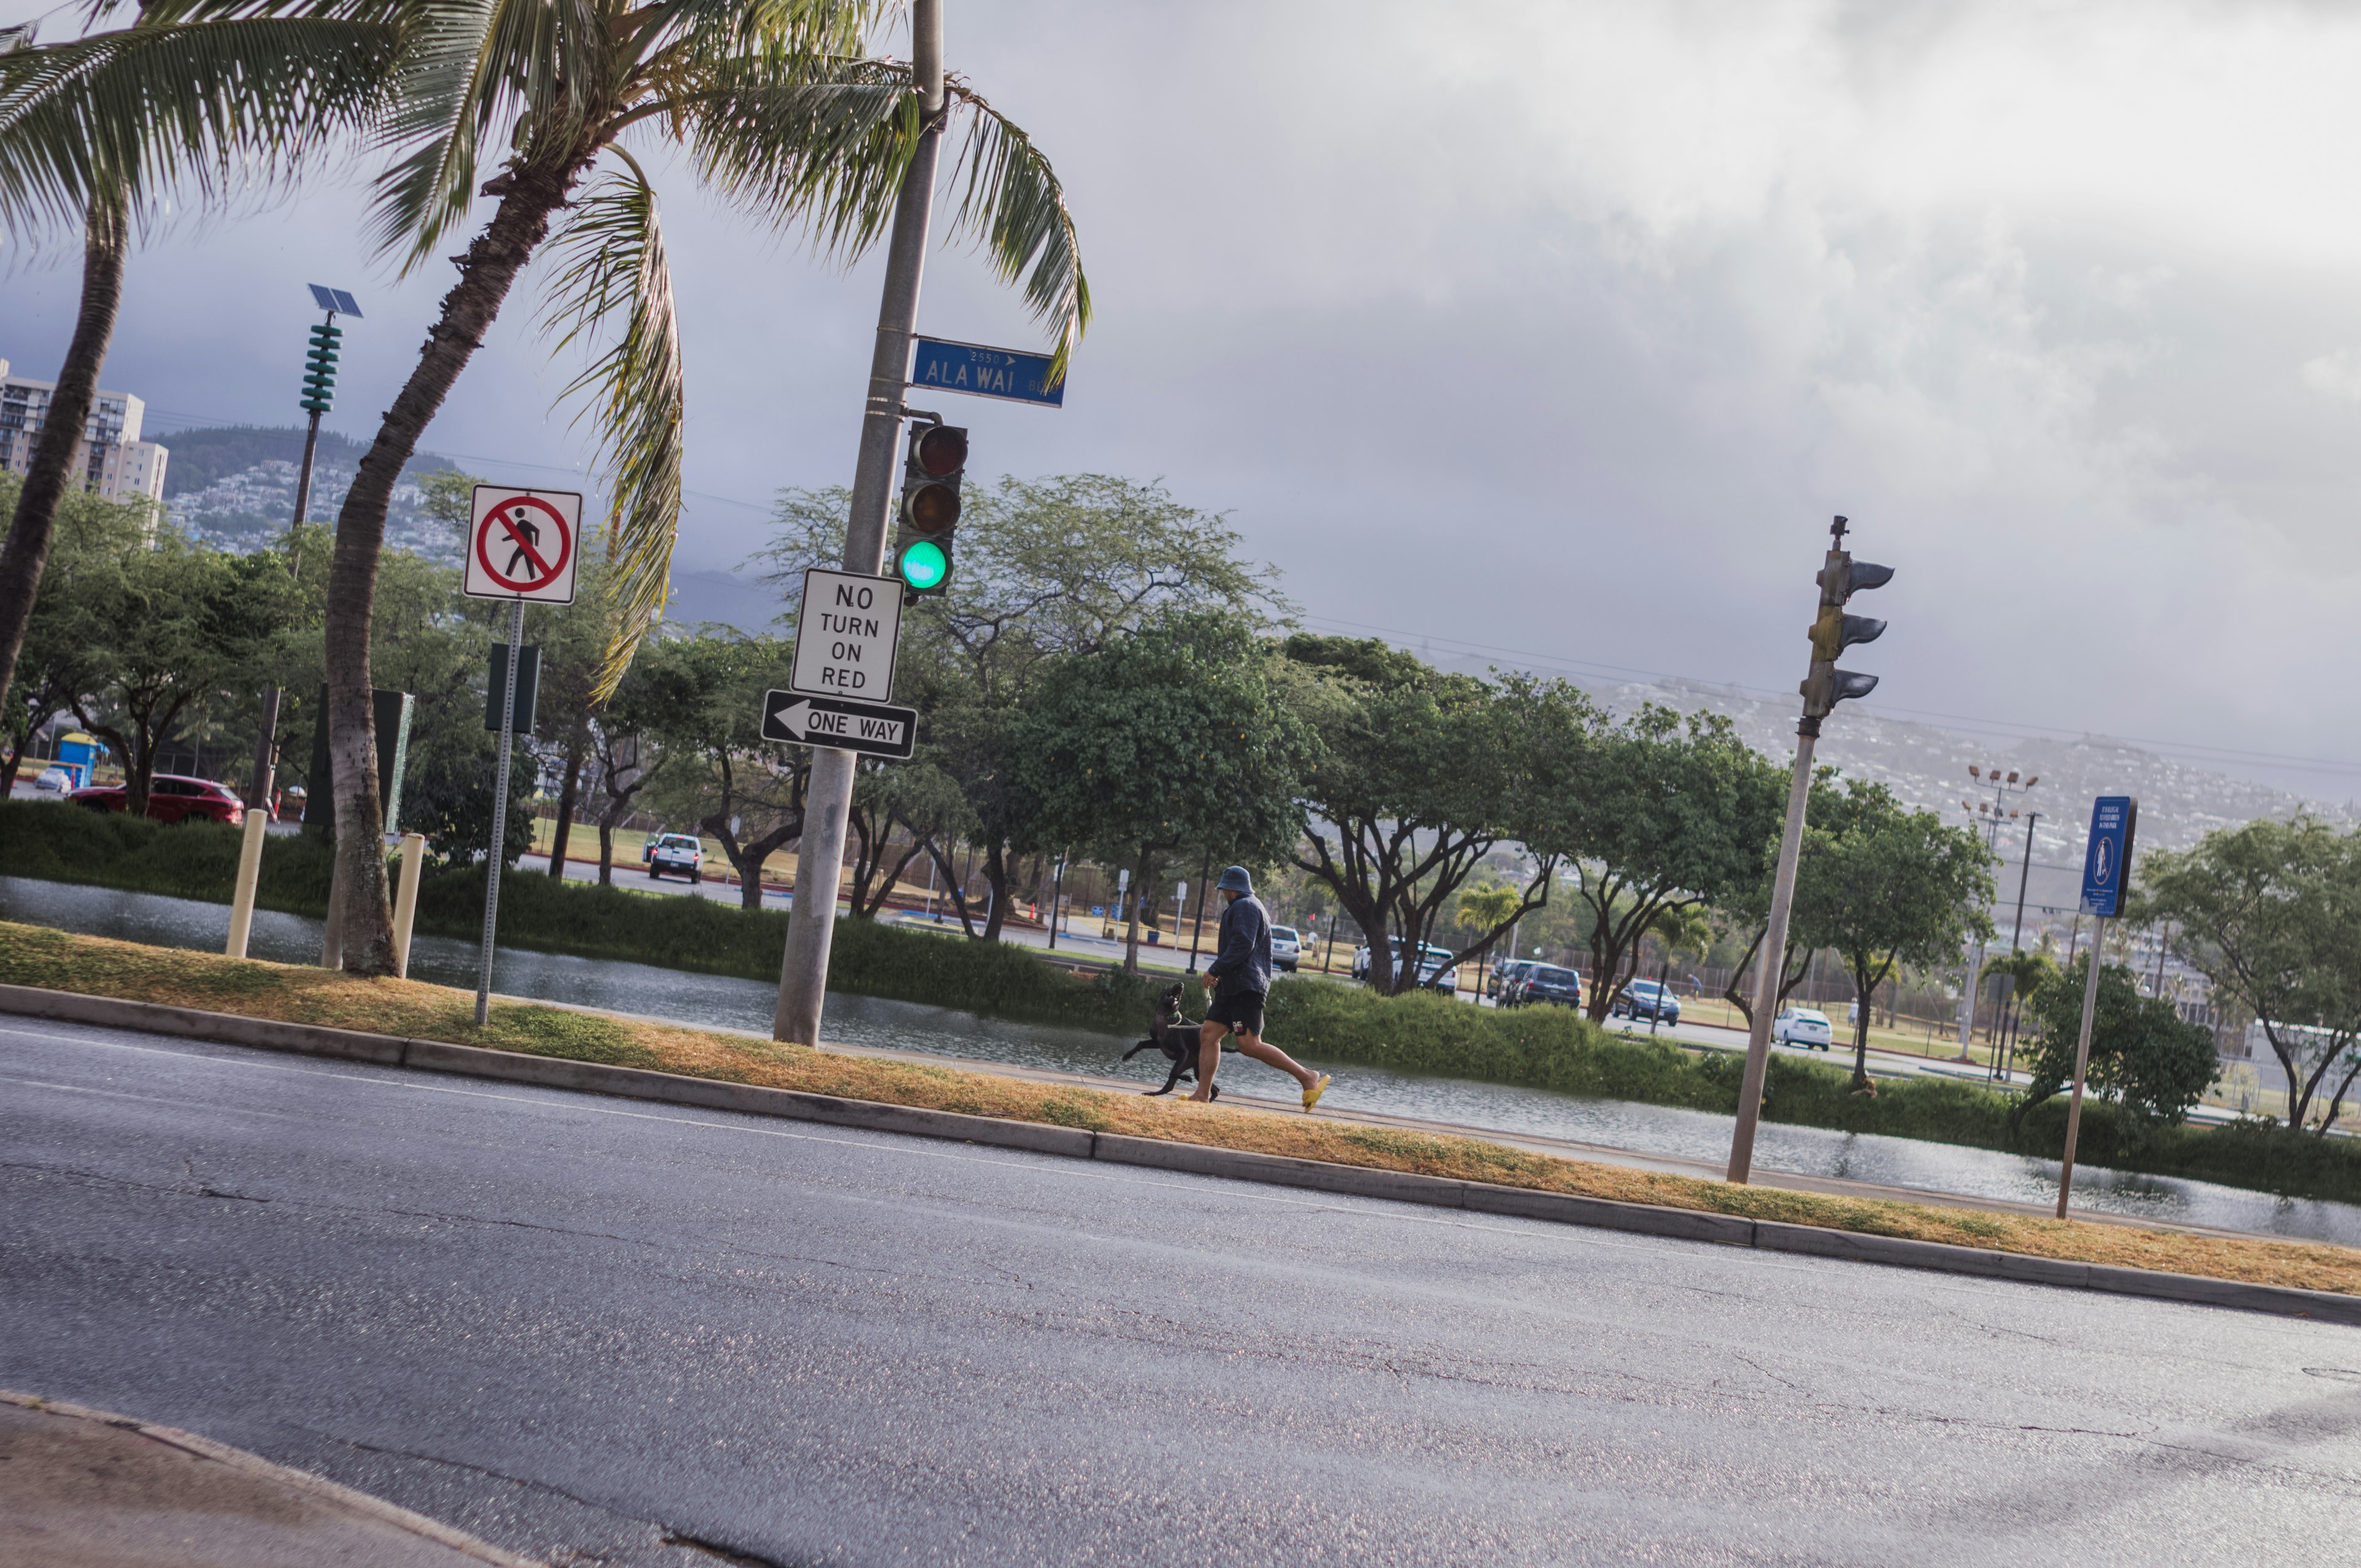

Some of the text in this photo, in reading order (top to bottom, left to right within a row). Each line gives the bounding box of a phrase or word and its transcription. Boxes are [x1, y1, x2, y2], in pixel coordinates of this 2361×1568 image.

[971, 351, 1000, 364] 2550
[925, 360, 968, 386] ALA
[977, 366, 1014, 392] WAI
[836, 584, 873, 609] NO
[821, 612, 879, 638] TURN
[832, 641, 861, 662] ON
[821, 667, 866, 689] RED
[808, 711, 898, 740] ONE WAY
